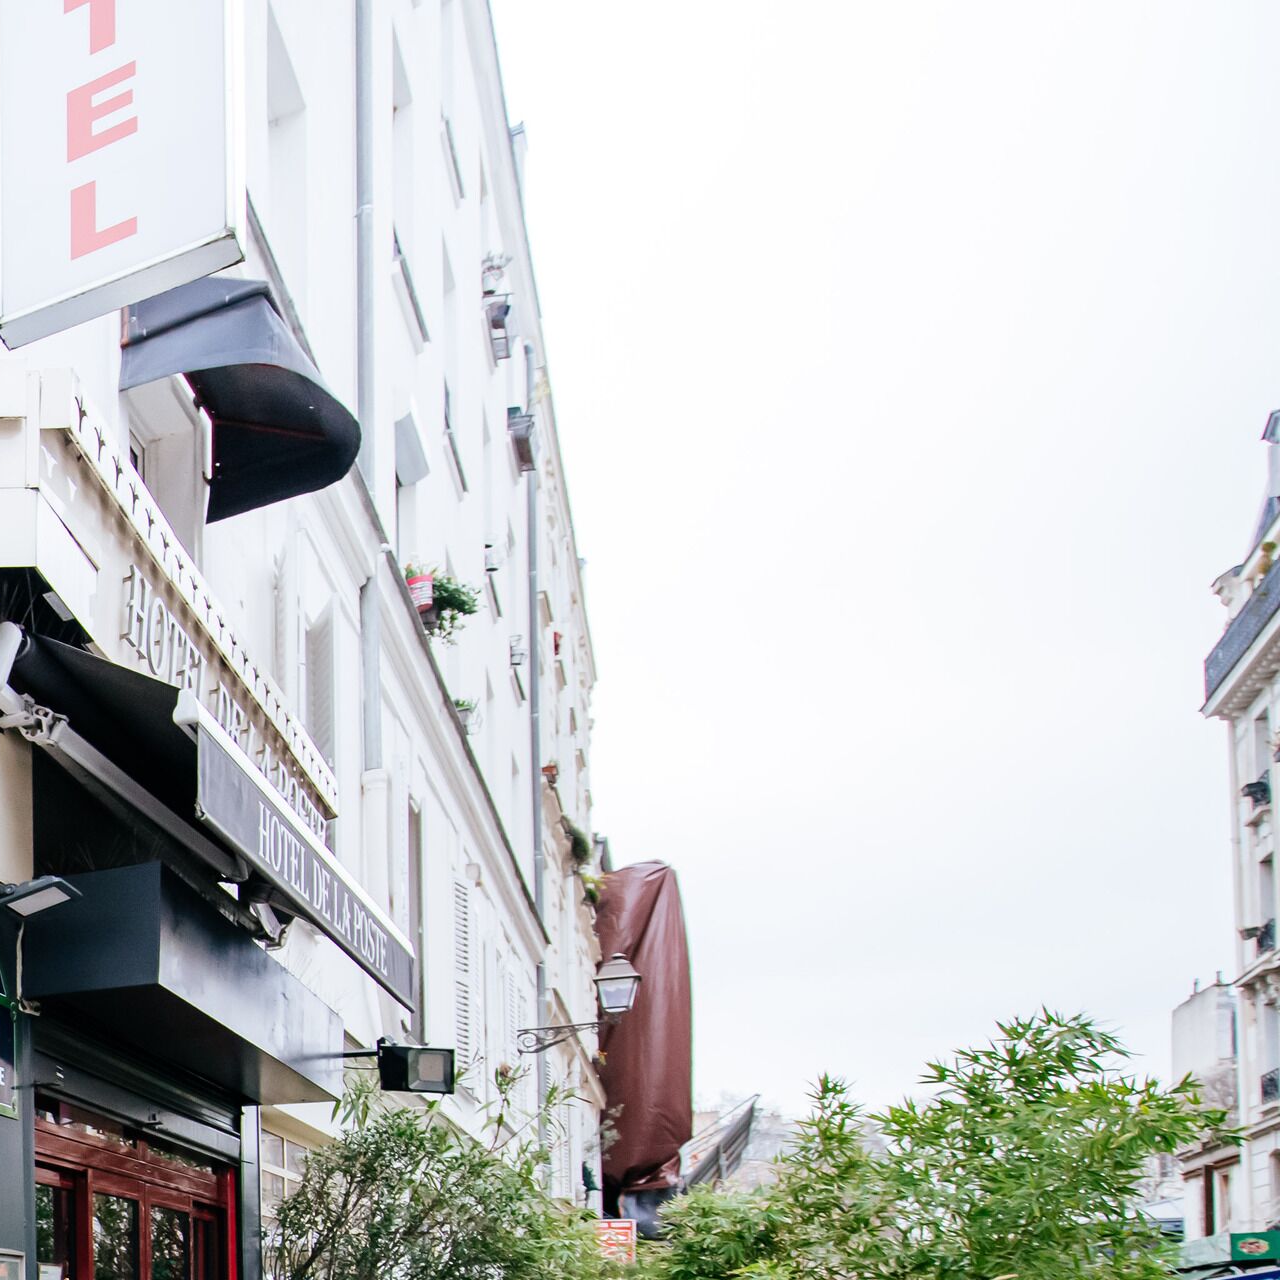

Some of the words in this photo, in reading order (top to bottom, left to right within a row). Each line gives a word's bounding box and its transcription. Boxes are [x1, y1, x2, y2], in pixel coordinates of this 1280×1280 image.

[258, 800, 310, 902] HOTEL
[312, 858, 331, 922] DE
[333, 880, 352, 942] LA
[353, 902, 388, 976] POSTE
